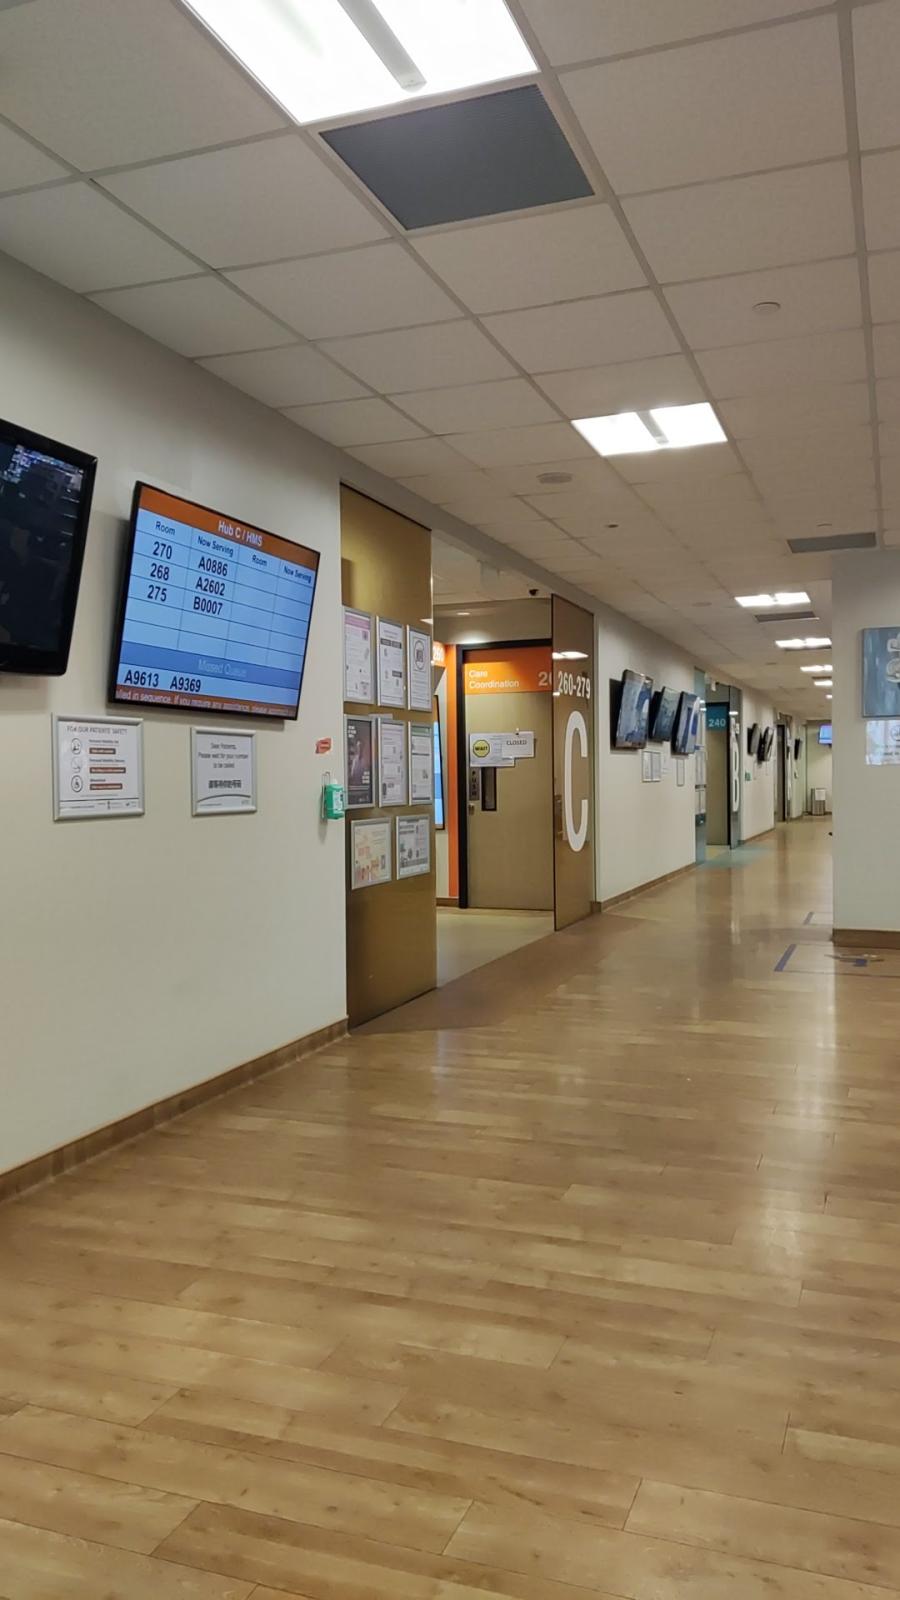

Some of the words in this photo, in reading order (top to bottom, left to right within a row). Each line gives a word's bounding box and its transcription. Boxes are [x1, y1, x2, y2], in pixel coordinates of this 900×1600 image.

[155, 521, 176, 535] Room
[218, 521, 233, 536] Hub
[235, 528, 241, 538] C
[246, 531, 263, 546] HMS
[153, 541, 172, 560] 270
[198, 536, 211, 547] Now
[212, 541, 234, 558] Serving
[150, 563, 170, 581] 268
[198, 556, 228, 577] A0886
[147, 585, 167, 602] 275
[195, 577, 226, 596] A2602
[193, 596, 223, 616] B0007
[124, 669, 160, 688] A9613
[169, 676, 201, 693] A9369
[469, 670, 488, 678] Care
[469, 680, 520, 689] Coordination
[558, 671, 591, 699] 260-279
[708, 718, 726, 727] 240
[565, 710, 588, 852] C
